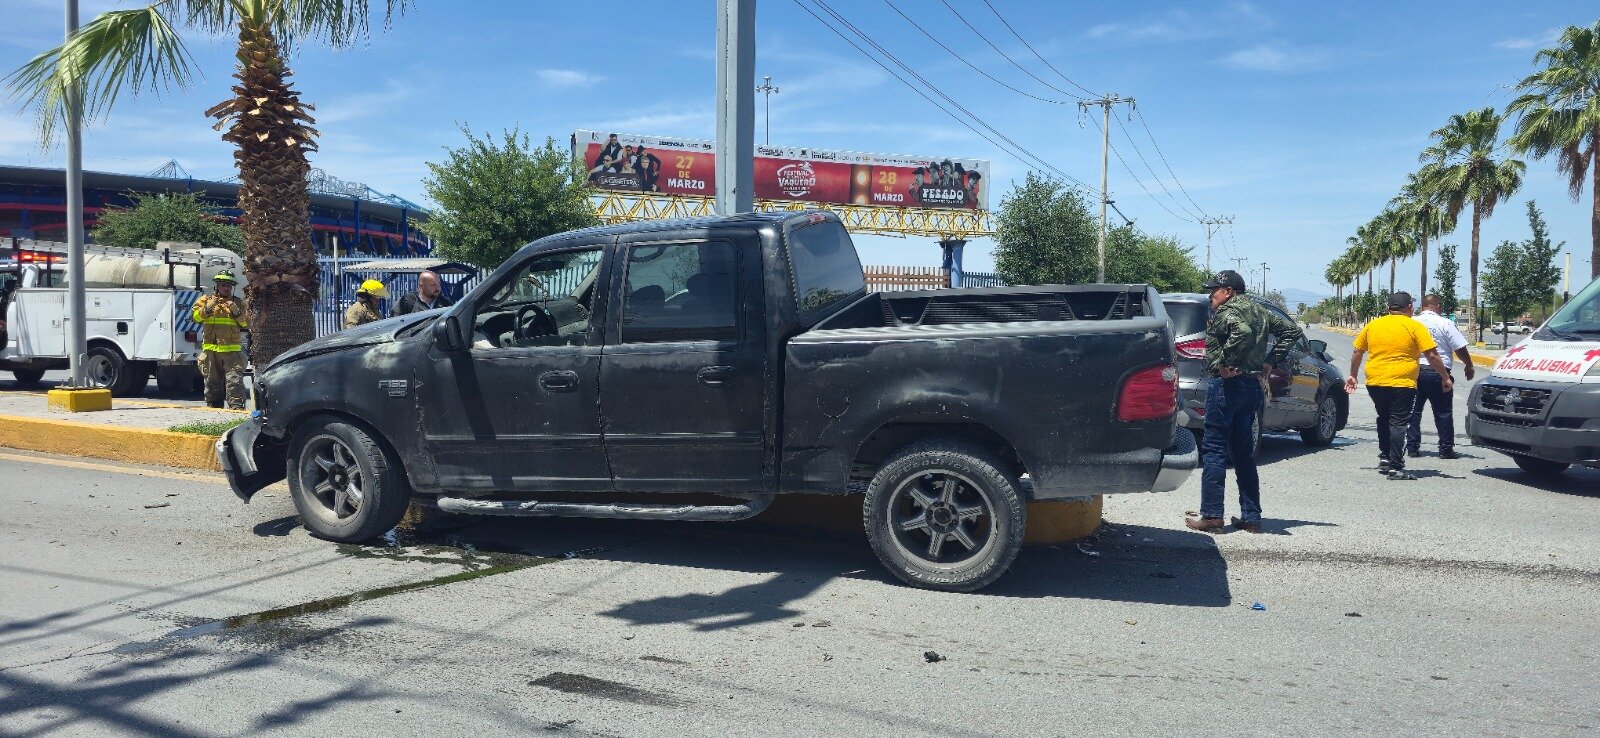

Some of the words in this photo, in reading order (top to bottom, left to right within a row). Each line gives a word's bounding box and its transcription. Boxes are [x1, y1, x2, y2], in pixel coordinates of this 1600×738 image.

[675, 155, 695, 170] 27
[678, 170, 690, 178] DE
[879, 171, 897, 185] 28
[667, 178, 705, 190] MARZO
[778, 177, 816, 187] VAQUERO
[874, 193, 904, 202] MARZO
[922, 188, 964, 200] PESADO
